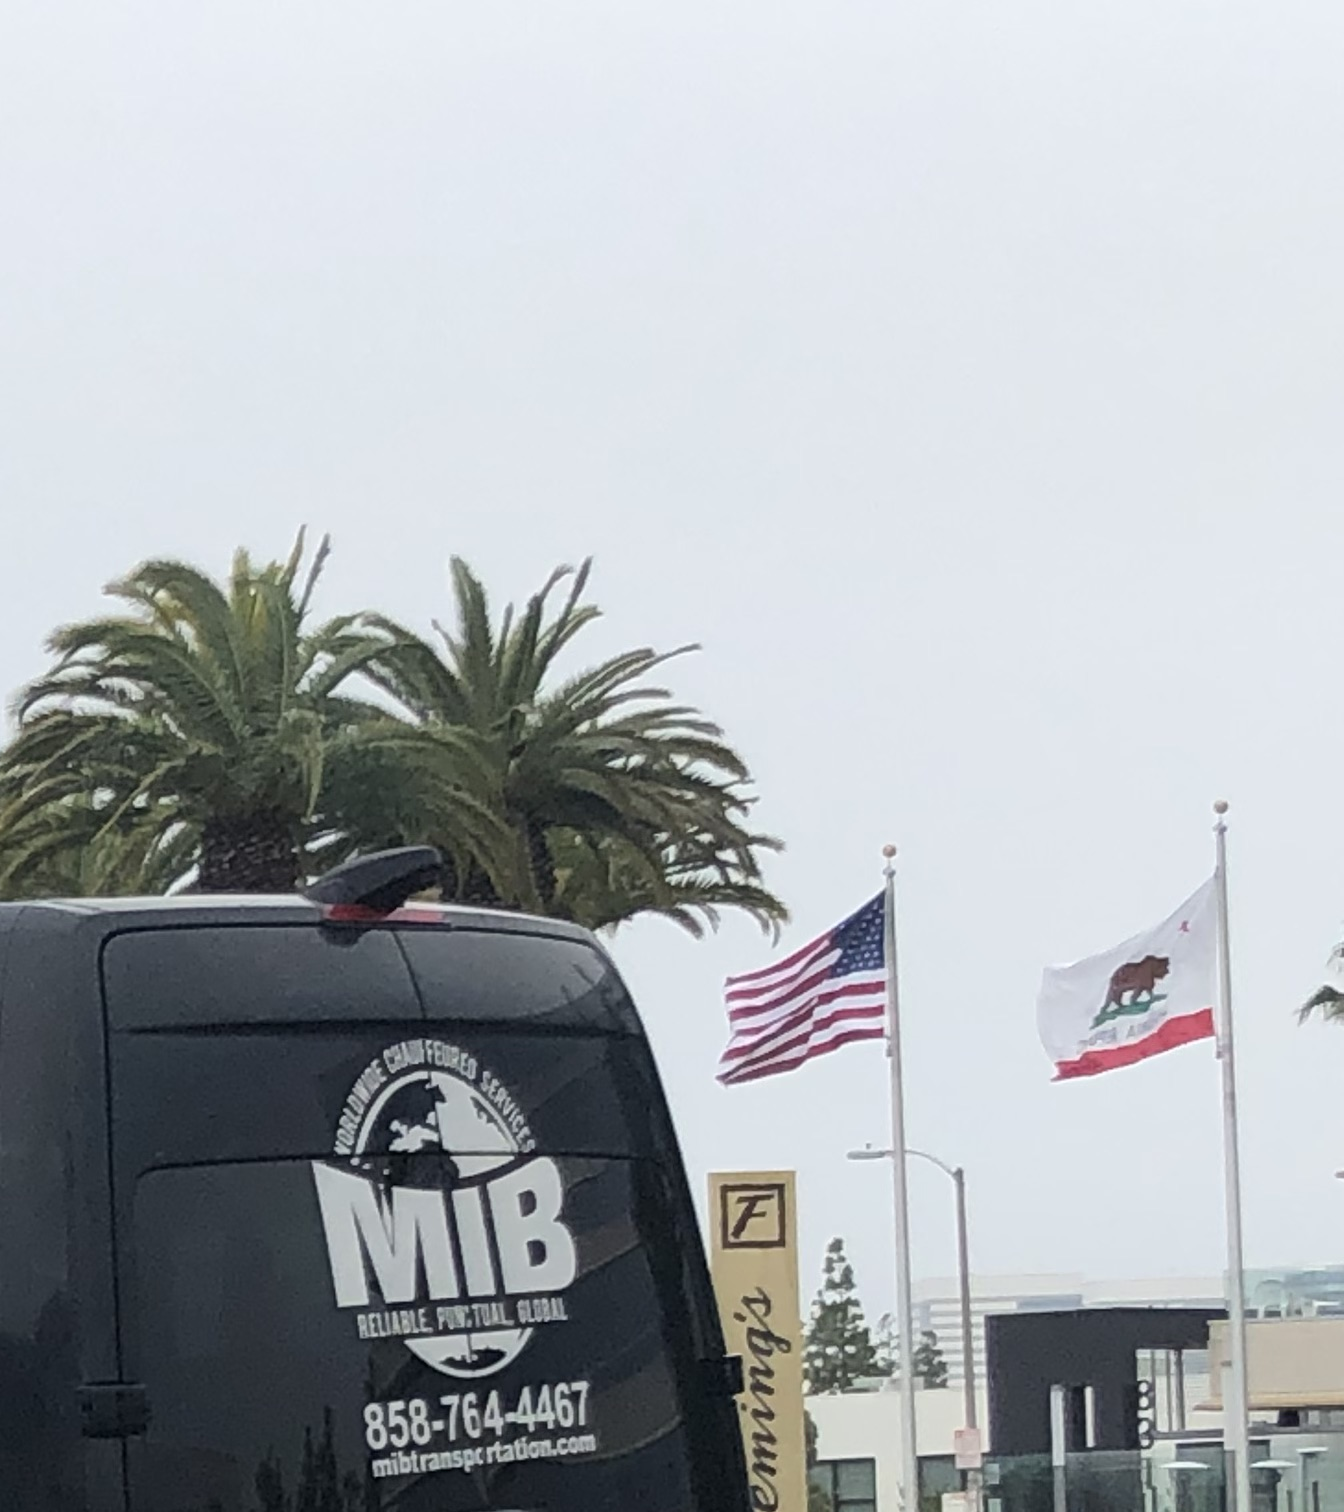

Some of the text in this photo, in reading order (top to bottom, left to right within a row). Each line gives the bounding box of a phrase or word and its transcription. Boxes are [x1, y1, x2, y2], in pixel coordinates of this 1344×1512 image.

[480, 1071, 536, 1153] SERVICES
[311, 1156, 577, 1308] MIB
[517, 1297, 568, 1325] GLOBAL
[363, 1380, 589, 1450] 858-764-4467
[371, 1434, 596, 1478] mibtransportation.com
